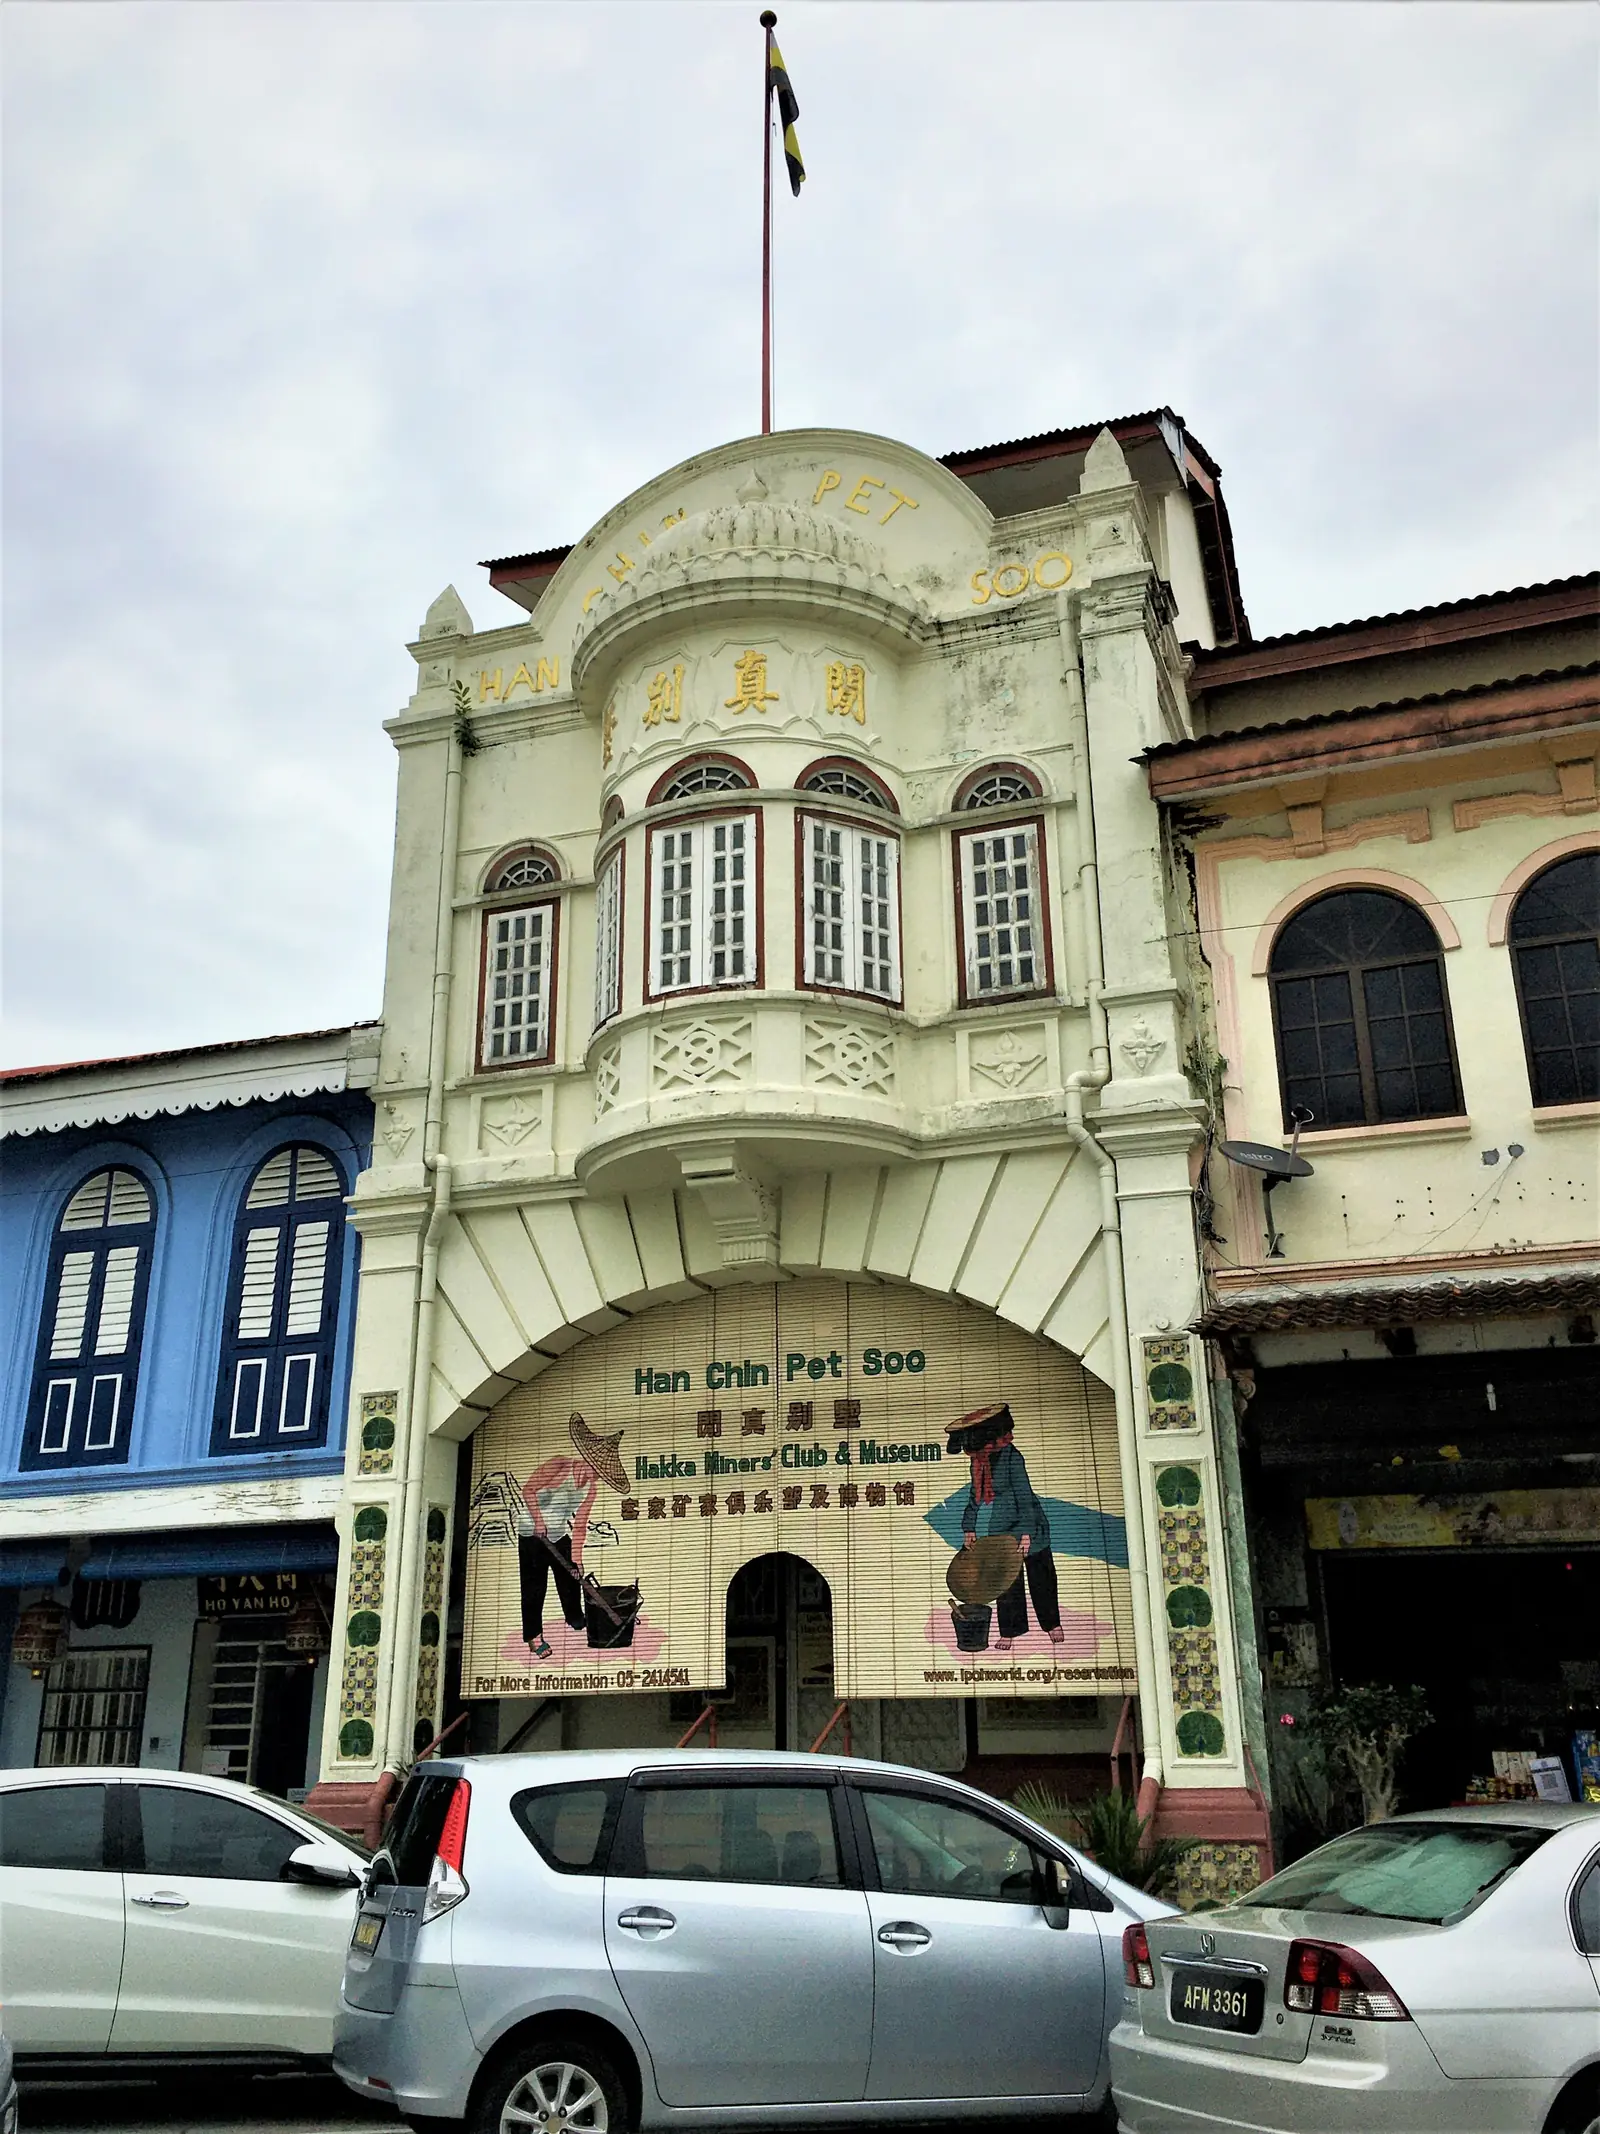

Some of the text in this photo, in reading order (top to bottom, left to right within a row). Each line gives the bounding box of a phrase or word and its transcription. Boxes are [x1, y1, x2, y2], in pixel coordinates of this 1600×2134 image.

[480, 654, 559, 703] HAN
[812, 469, 919, 526] PET
[970, 551, 1073, 605] SOO
[634, 1347, 926, 1395] Han Chin Pet Soo
[635, 1453, 696, 1480] Hakka
[780, 1442, 828, 1468] Club
[835, 1440, 852, 1466] &
[859, 1440, 942, 1465] Museum
[205, 1599, 226, 1611] HO
[232, 1596, 264, 1611] YAN
[475, 1676, 497, 1693] For
[499, 1675, 530, 1691] More
[1184, 1985, 1247, 2017] AFM 3361
